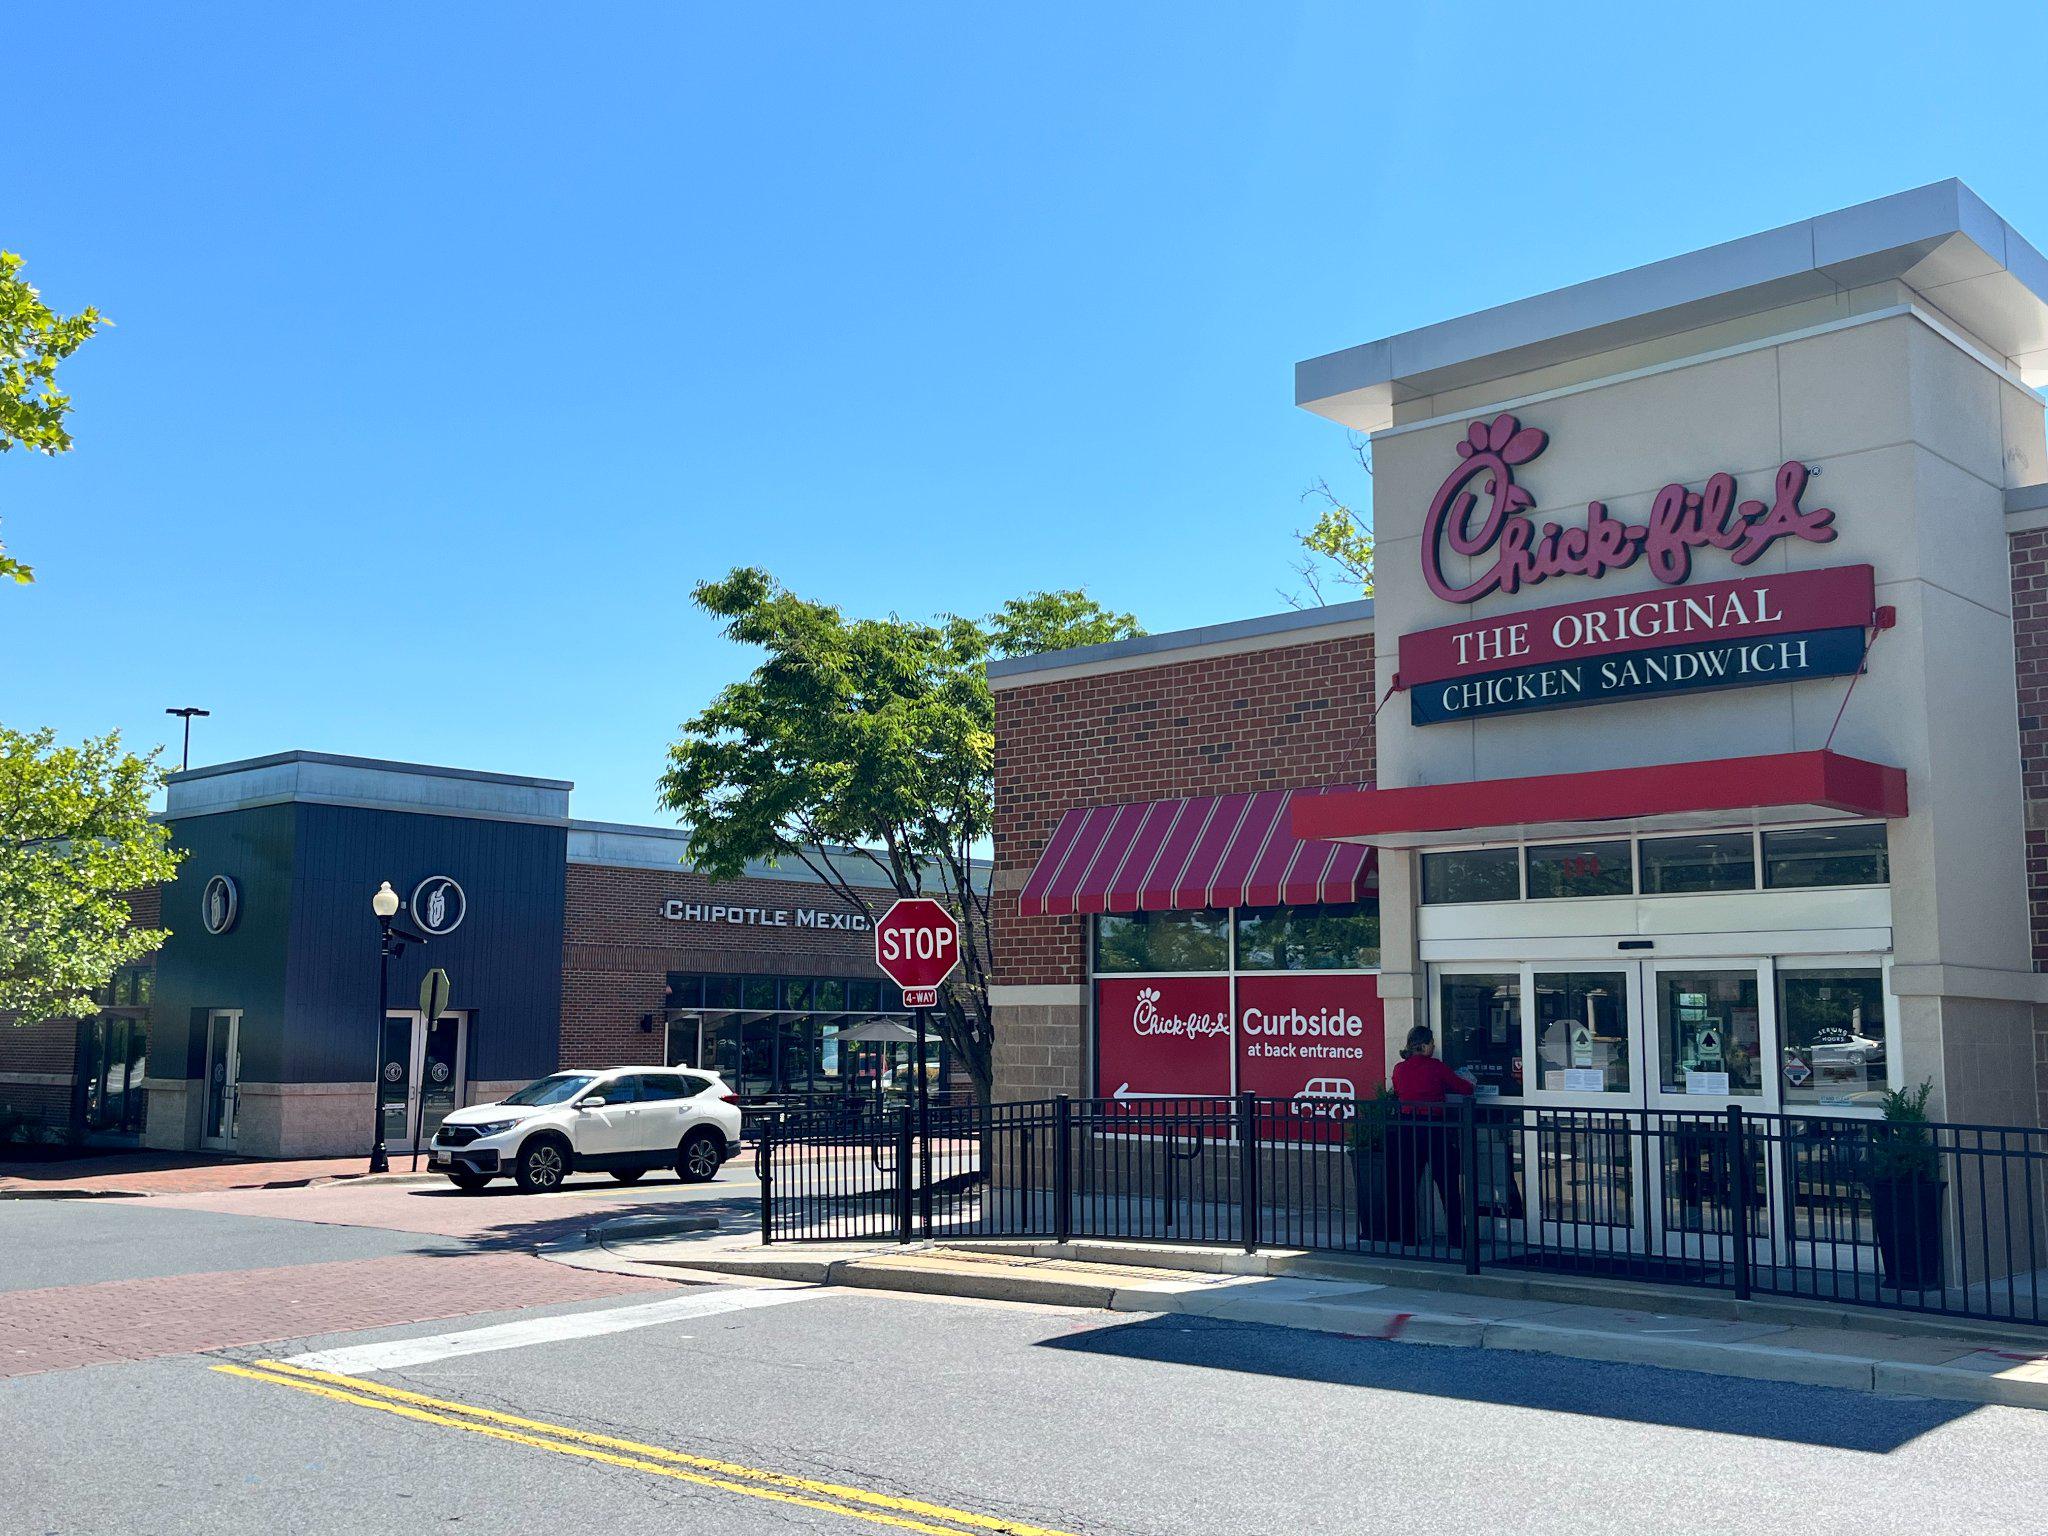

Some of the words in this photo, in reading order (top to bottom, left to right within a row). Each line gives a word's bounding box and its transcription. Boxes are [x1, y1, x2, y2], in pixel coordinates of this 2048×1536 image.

[1421, 440, 1838, 604] Chick-fil-A
[1452, 622, 1529, 665] THE
[1552, 588, 1782, 650] ORIGINAL
[1442, 666, 1582, 712] CHICKEN
[1601, 640, 1809, 689] SANDWICH
[667, 900, 788, 927] CHIPOTLE
[797, 908, 871, 931] MEXIC
[882, 927, 953, 960] STOP
[906, 991, 934, 1004] 4-WAY
[1133, 998, 1230, 1040] Chick-fil-A
[1243, 1008, 1363, 1037] Curbside
[1248, 1043, 1261, 1056] at
[1264, 1042, 1296, 1058] back
[1300, 1044, 1363, 1059] entrance
